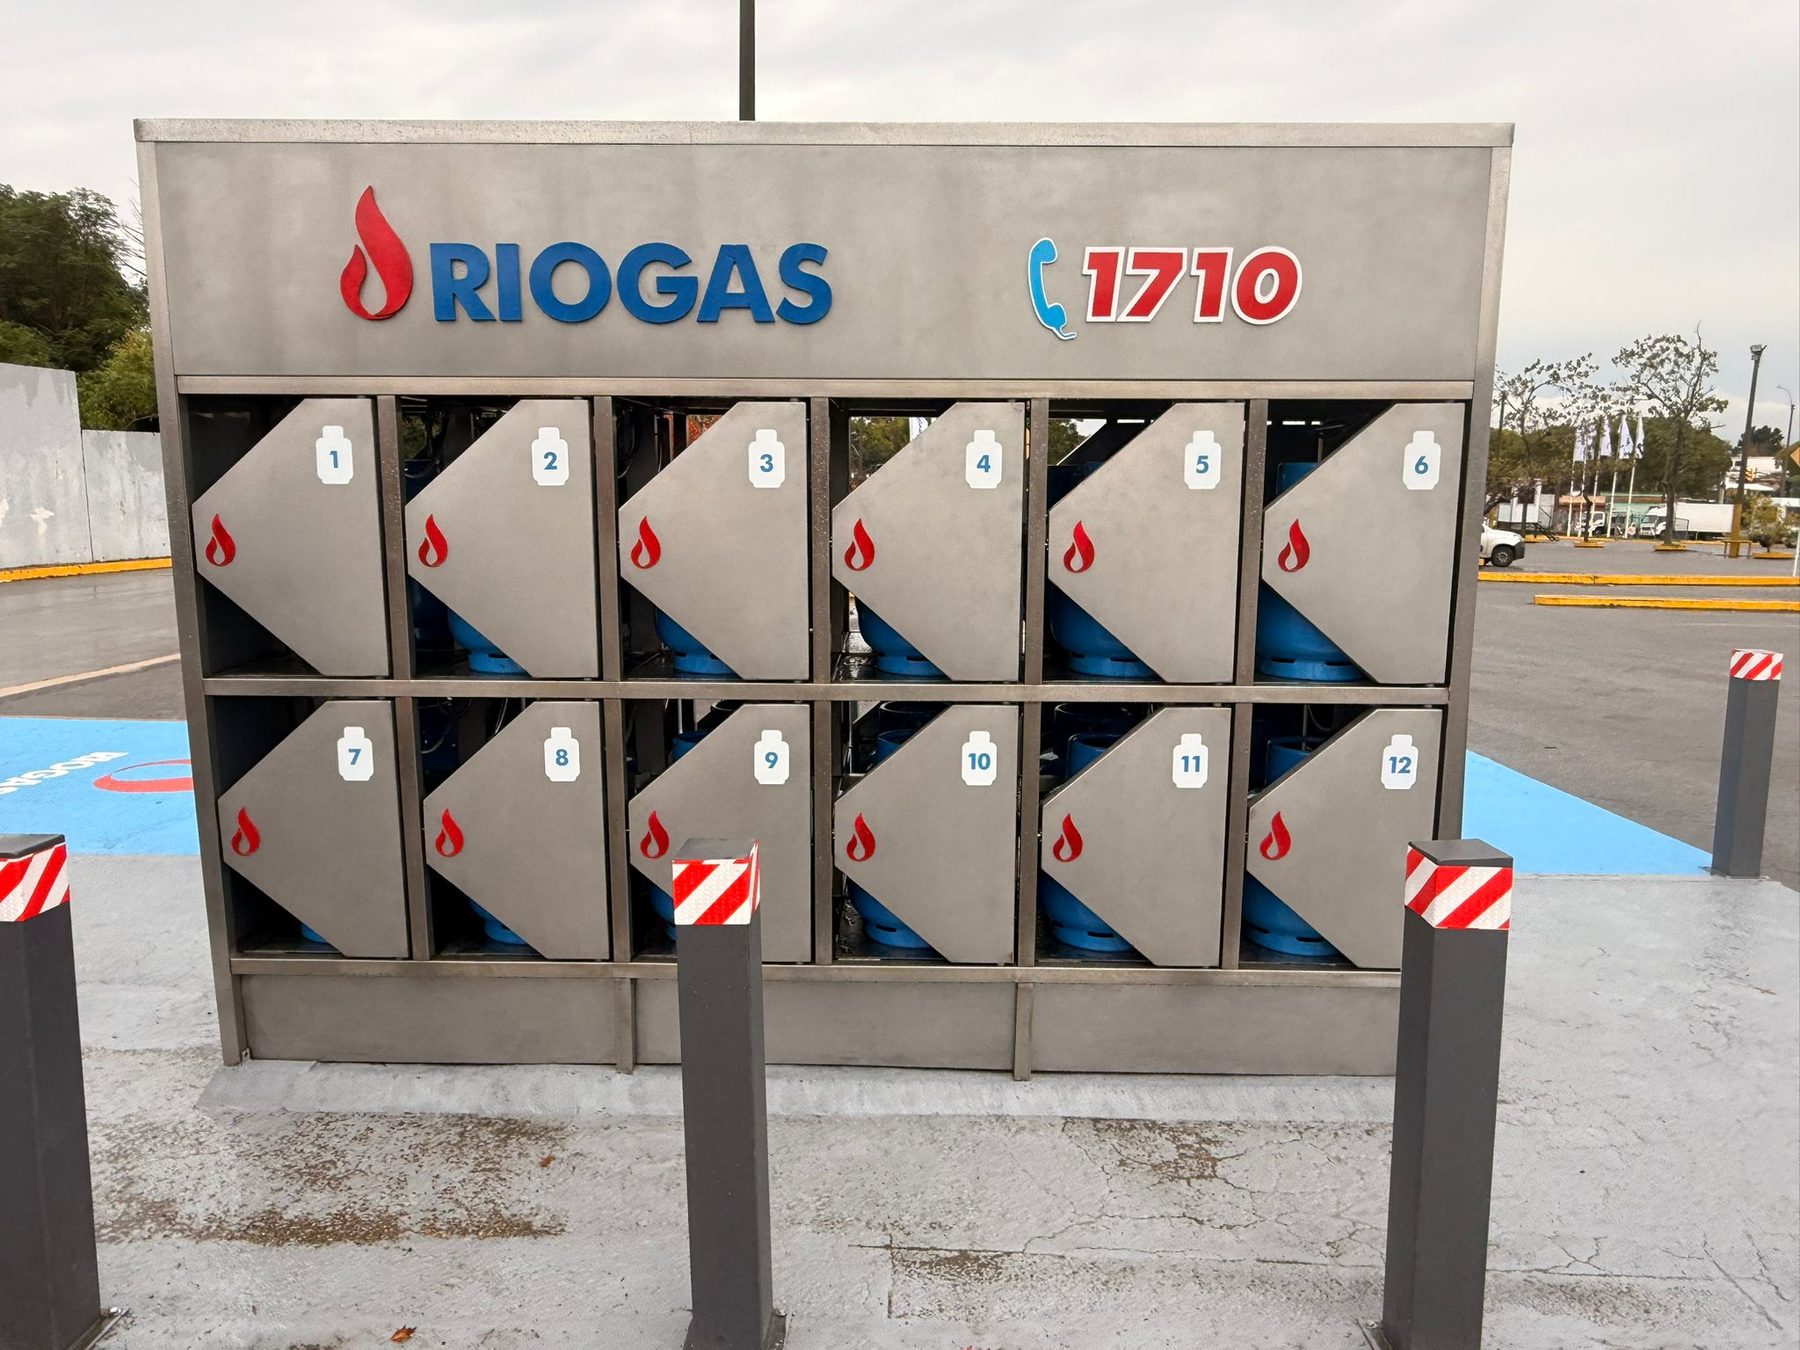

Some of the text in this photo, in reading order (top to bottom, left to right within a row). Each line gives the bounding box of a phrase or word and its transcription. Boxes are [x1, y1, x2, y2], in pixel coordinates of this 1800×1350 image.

[430, 242, 833, 325] RIOGAS
[1082, 246, 1303, 325] 1710
[329, 450, 339, 469] 1
[544, 451, 558, 470] 2
[760, 453, 774, 473] 3
[977, 454, 991, 473] 4
[1196, 455, 1209, 474] 5
[1414, 455, 1429, 475] 6
[348, 749, 362, 766] 7
[555, 749, 569, 766] 8
[764, 751, 779, 769] 9
[968, 752, 992, 771] 10
[1180, 755, 1202, 773] 11
[1387, 756, 1412, 774] 12
